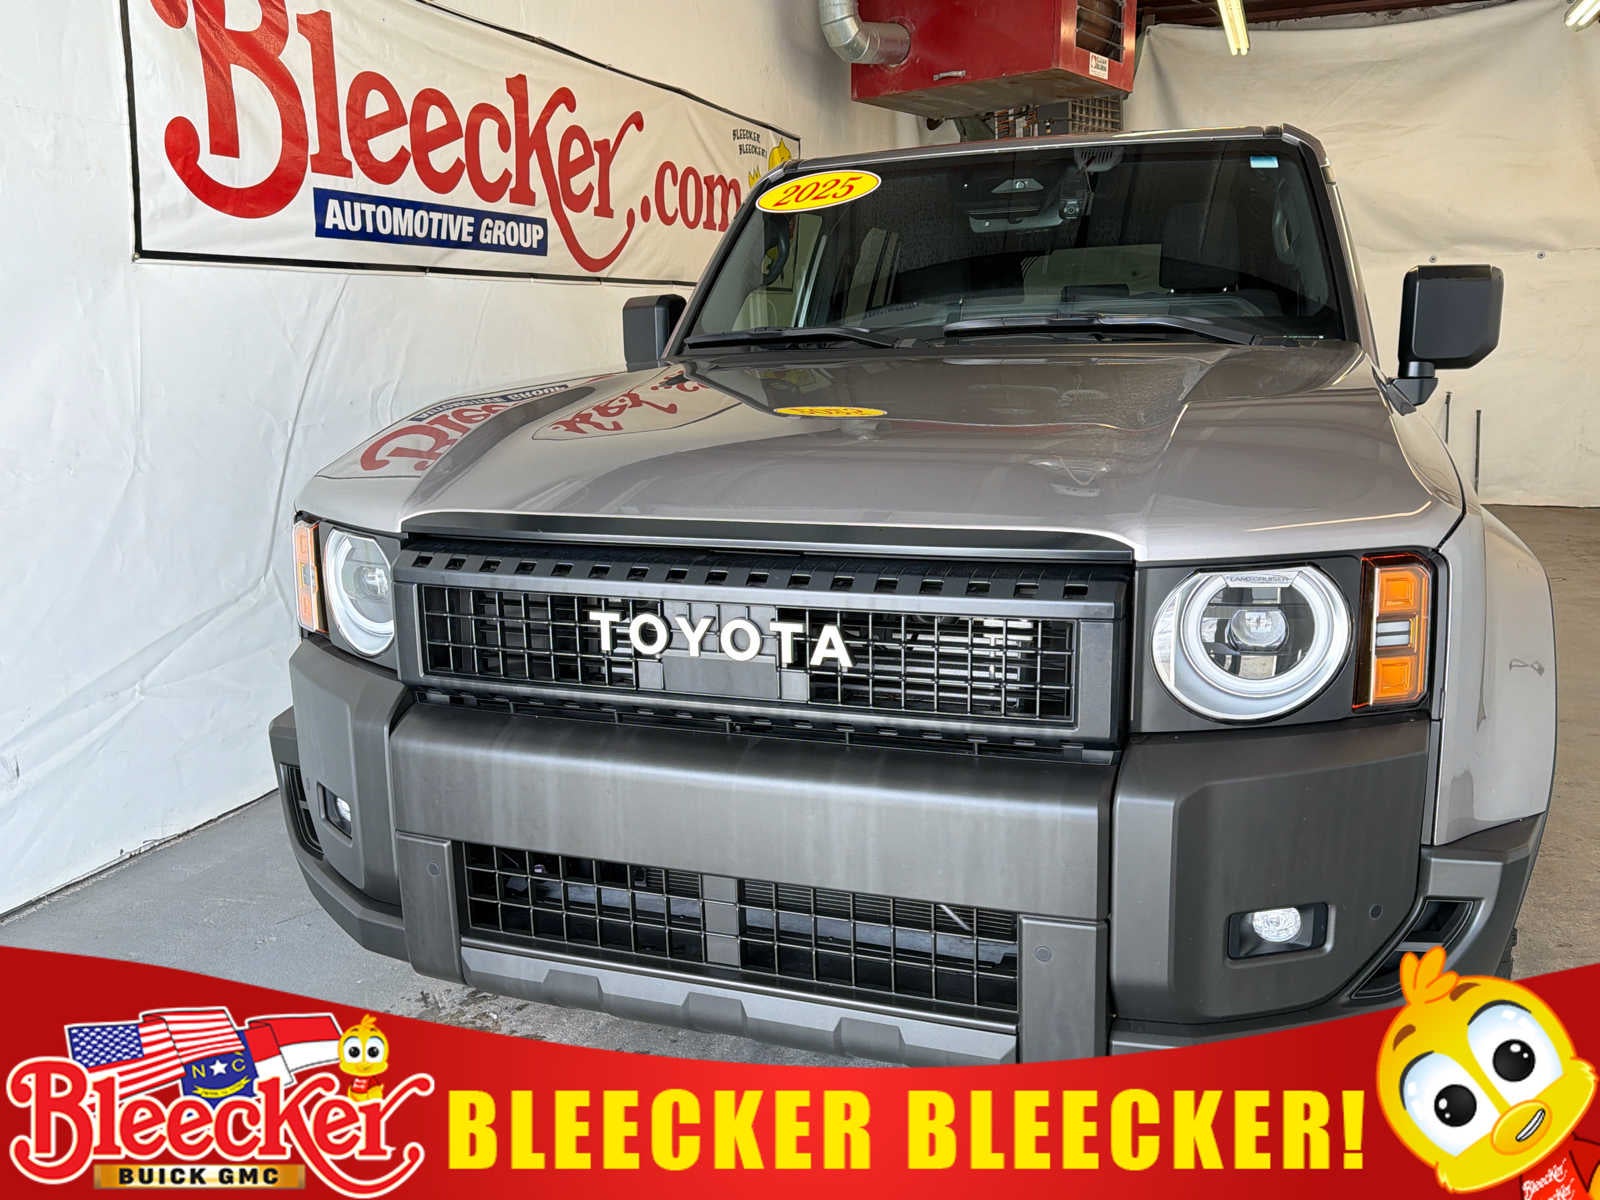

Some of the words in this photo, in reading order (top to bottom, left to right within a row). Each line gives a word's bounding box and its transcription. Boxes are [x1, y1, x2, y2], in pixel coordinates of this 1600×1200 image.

[773, 176, 864, 207] 2025
[325, 198, 475, 243] AUTOMOTIVE
[479, 216, 545, 249] GROUP
[589, 610, 853, 670] TOYOTA
